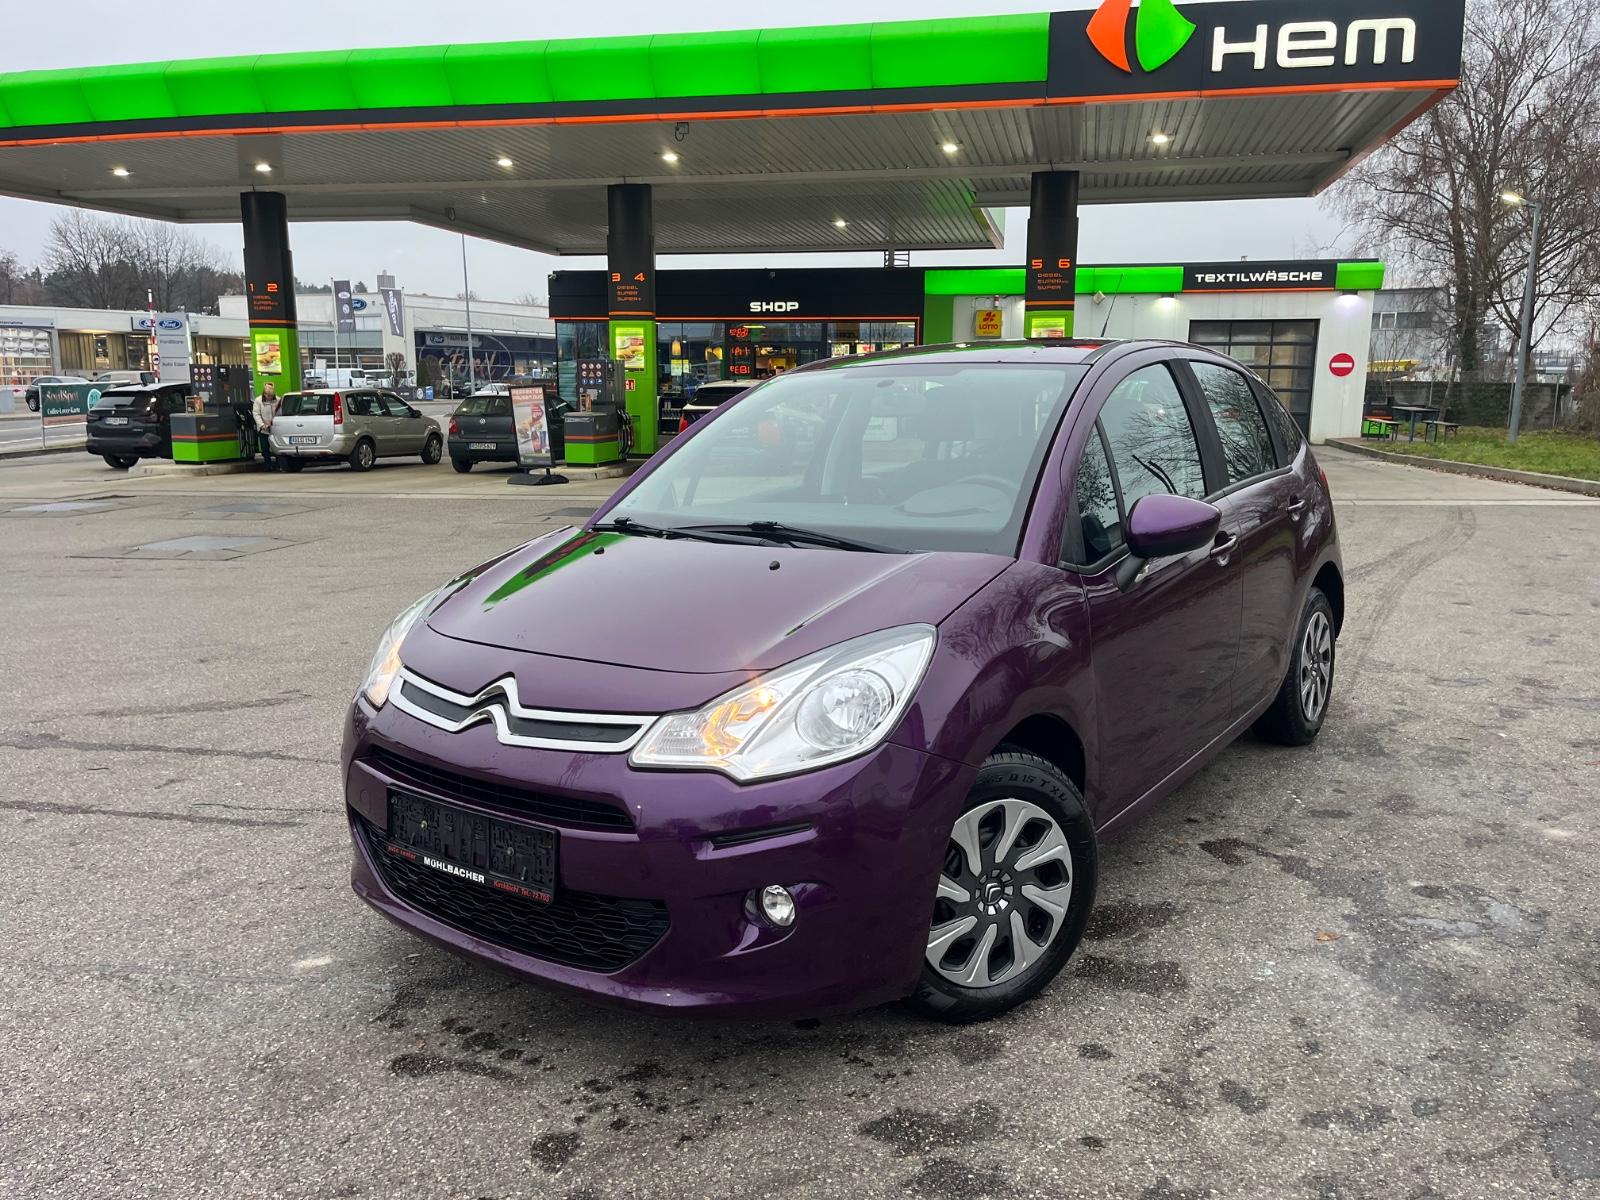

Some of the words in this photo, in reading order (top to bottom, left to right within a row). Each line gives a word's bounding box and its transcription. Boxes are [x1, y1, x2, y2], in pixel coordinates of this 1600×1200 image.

[1031, 259, 1043, 269] 5
[1058, 258, 1071, 269] 6
[611, 272, 621, 282] 3
[634, 272, 645, 282] 4
[267, 283, 278, 292] 2
[750, 301, 799, 312] SHOP
[423, 856, 485, 884] MÜHLBACHER
